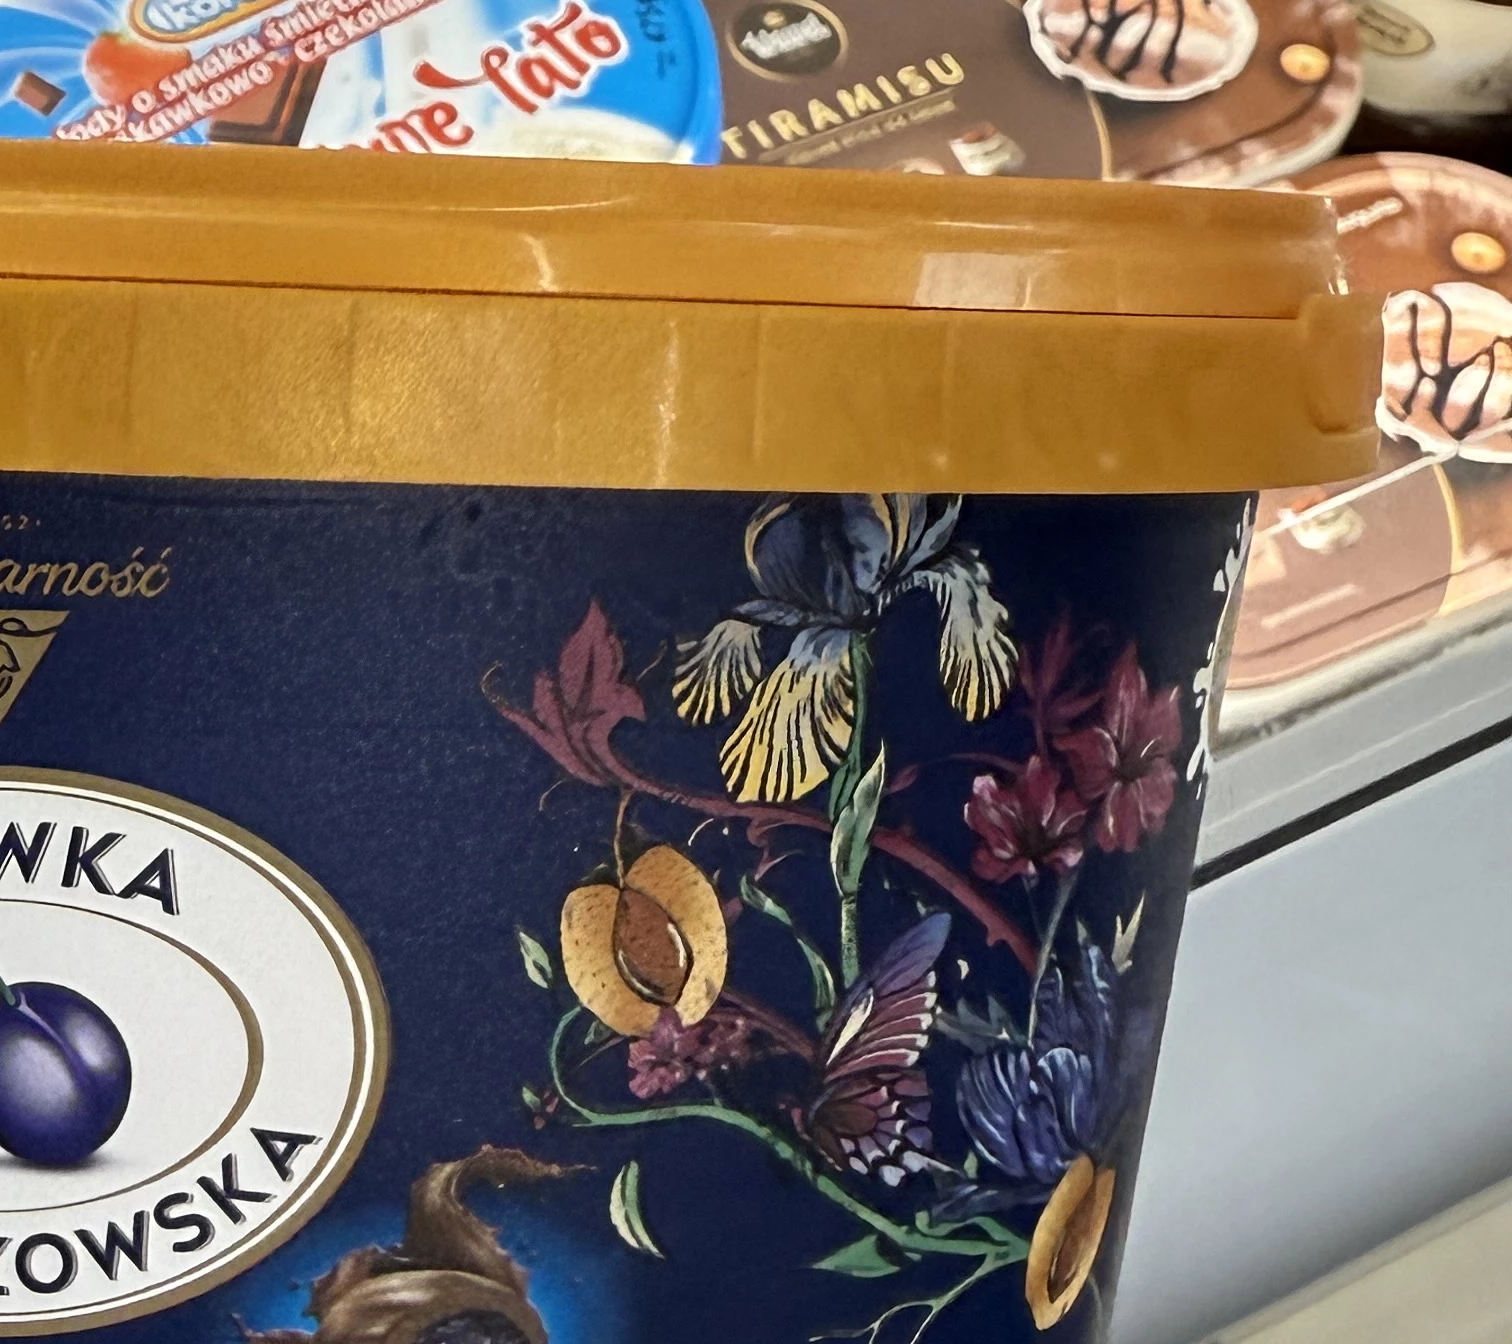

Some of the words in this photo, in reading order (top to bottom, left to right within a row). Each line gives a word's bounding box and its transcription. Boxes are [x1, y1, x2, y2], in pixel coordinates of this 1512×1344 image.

[158, 36, 265, 102] smaku
[414, 1, 621, 115] lato
[721, 52, 965, 159] TIRAMISU
